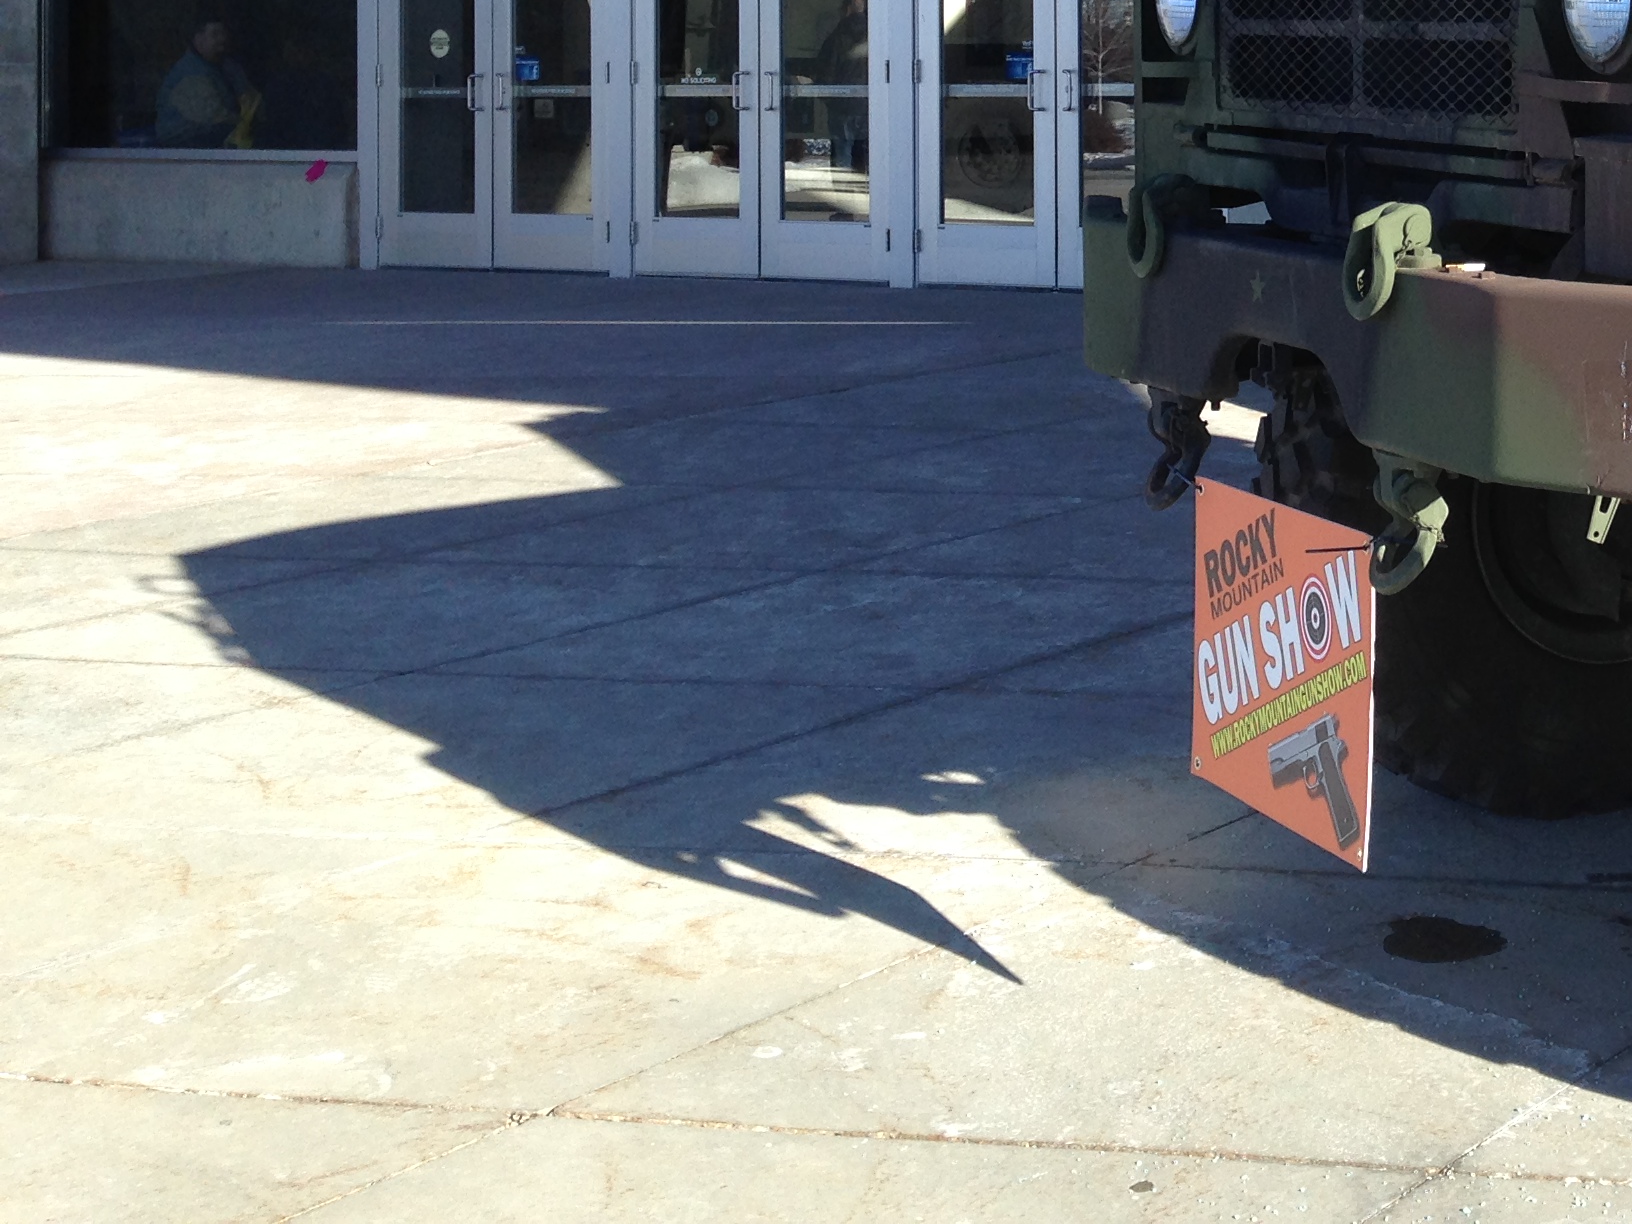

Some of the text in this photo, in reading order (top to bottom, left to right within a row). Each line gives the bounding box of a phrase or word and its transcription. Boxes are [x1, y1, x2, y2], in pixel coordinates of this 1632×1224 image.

[1204, 507, 1278, 598] ROCKY
[1210, 558, 1285, 620] MOUNTAIN
[1197, 550, 1362, 725] GUN SHOW
[1210, 651, 1368, 760] WWW.ROCKYMOUNTAINGUNSHOW.COM
